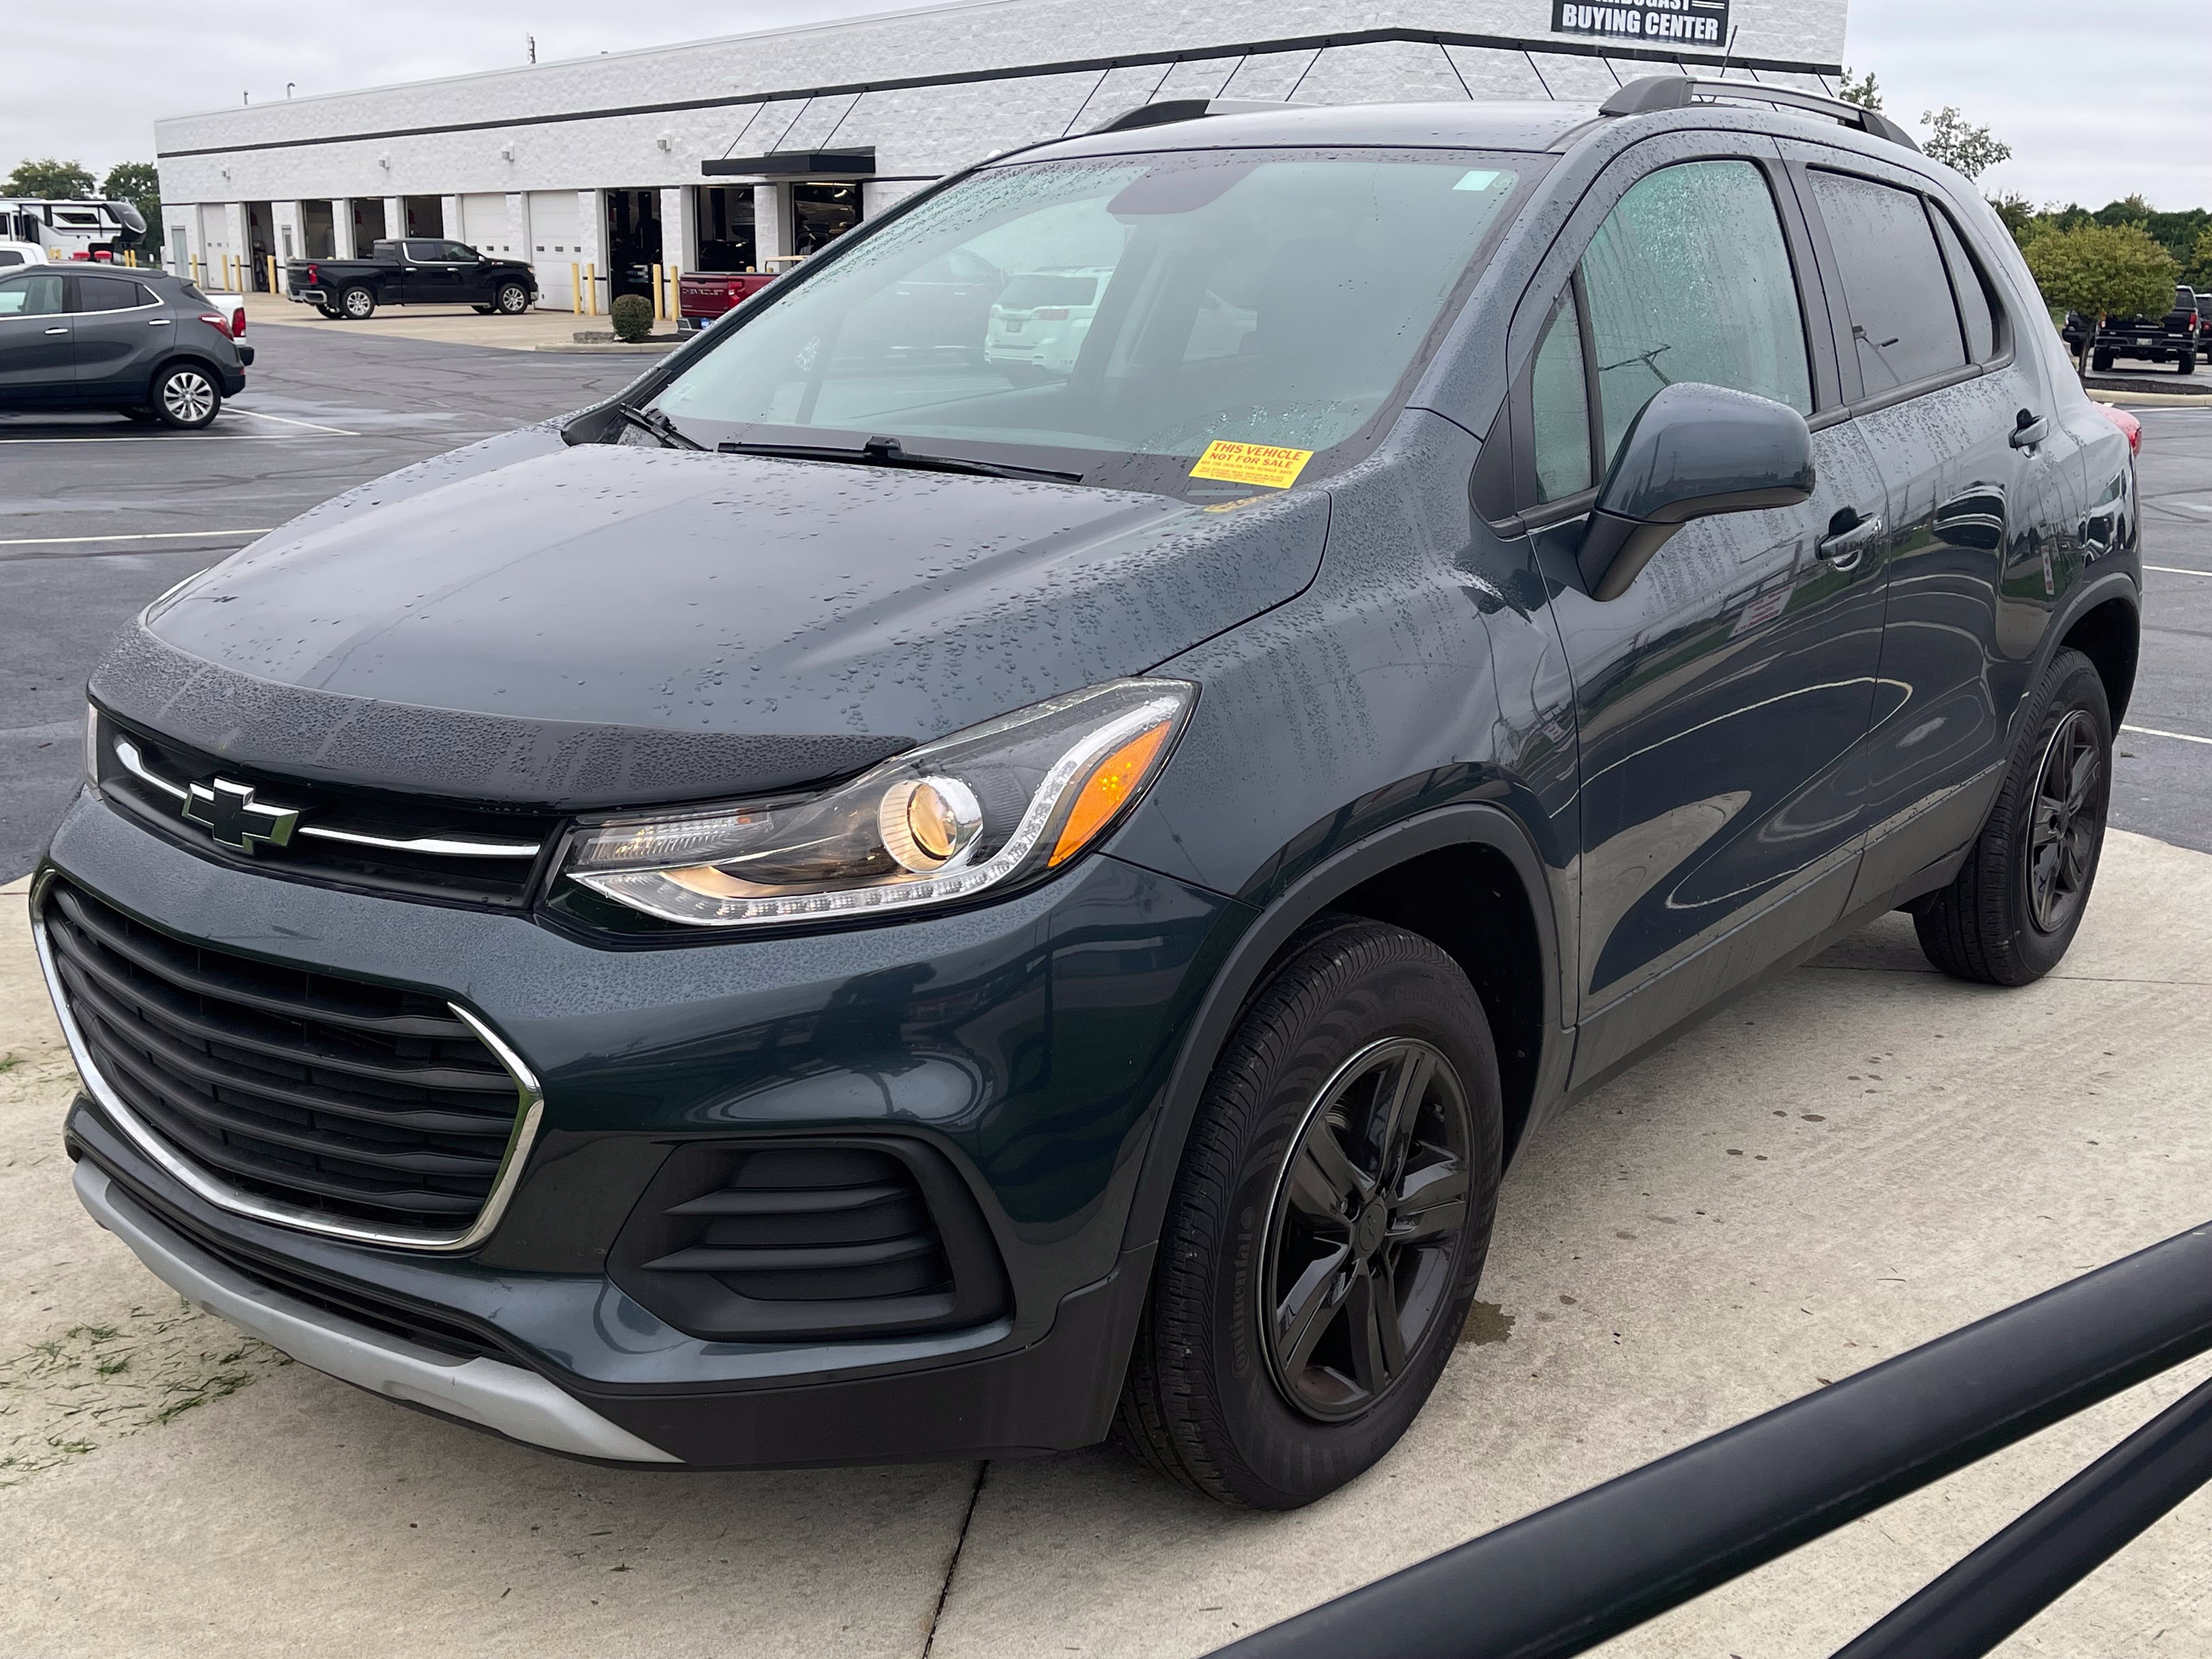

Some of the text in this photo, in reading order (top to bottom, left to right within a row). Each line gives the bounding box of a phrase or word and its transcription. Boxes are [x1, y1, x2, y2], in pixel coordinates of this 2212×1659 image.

[1561, 3, 1719, 41] BUYING CENTER
[1214, 443, 1304, 460] THIS VEHICLE
[1209, 453, 1294, 468] NOT FOR SALE
